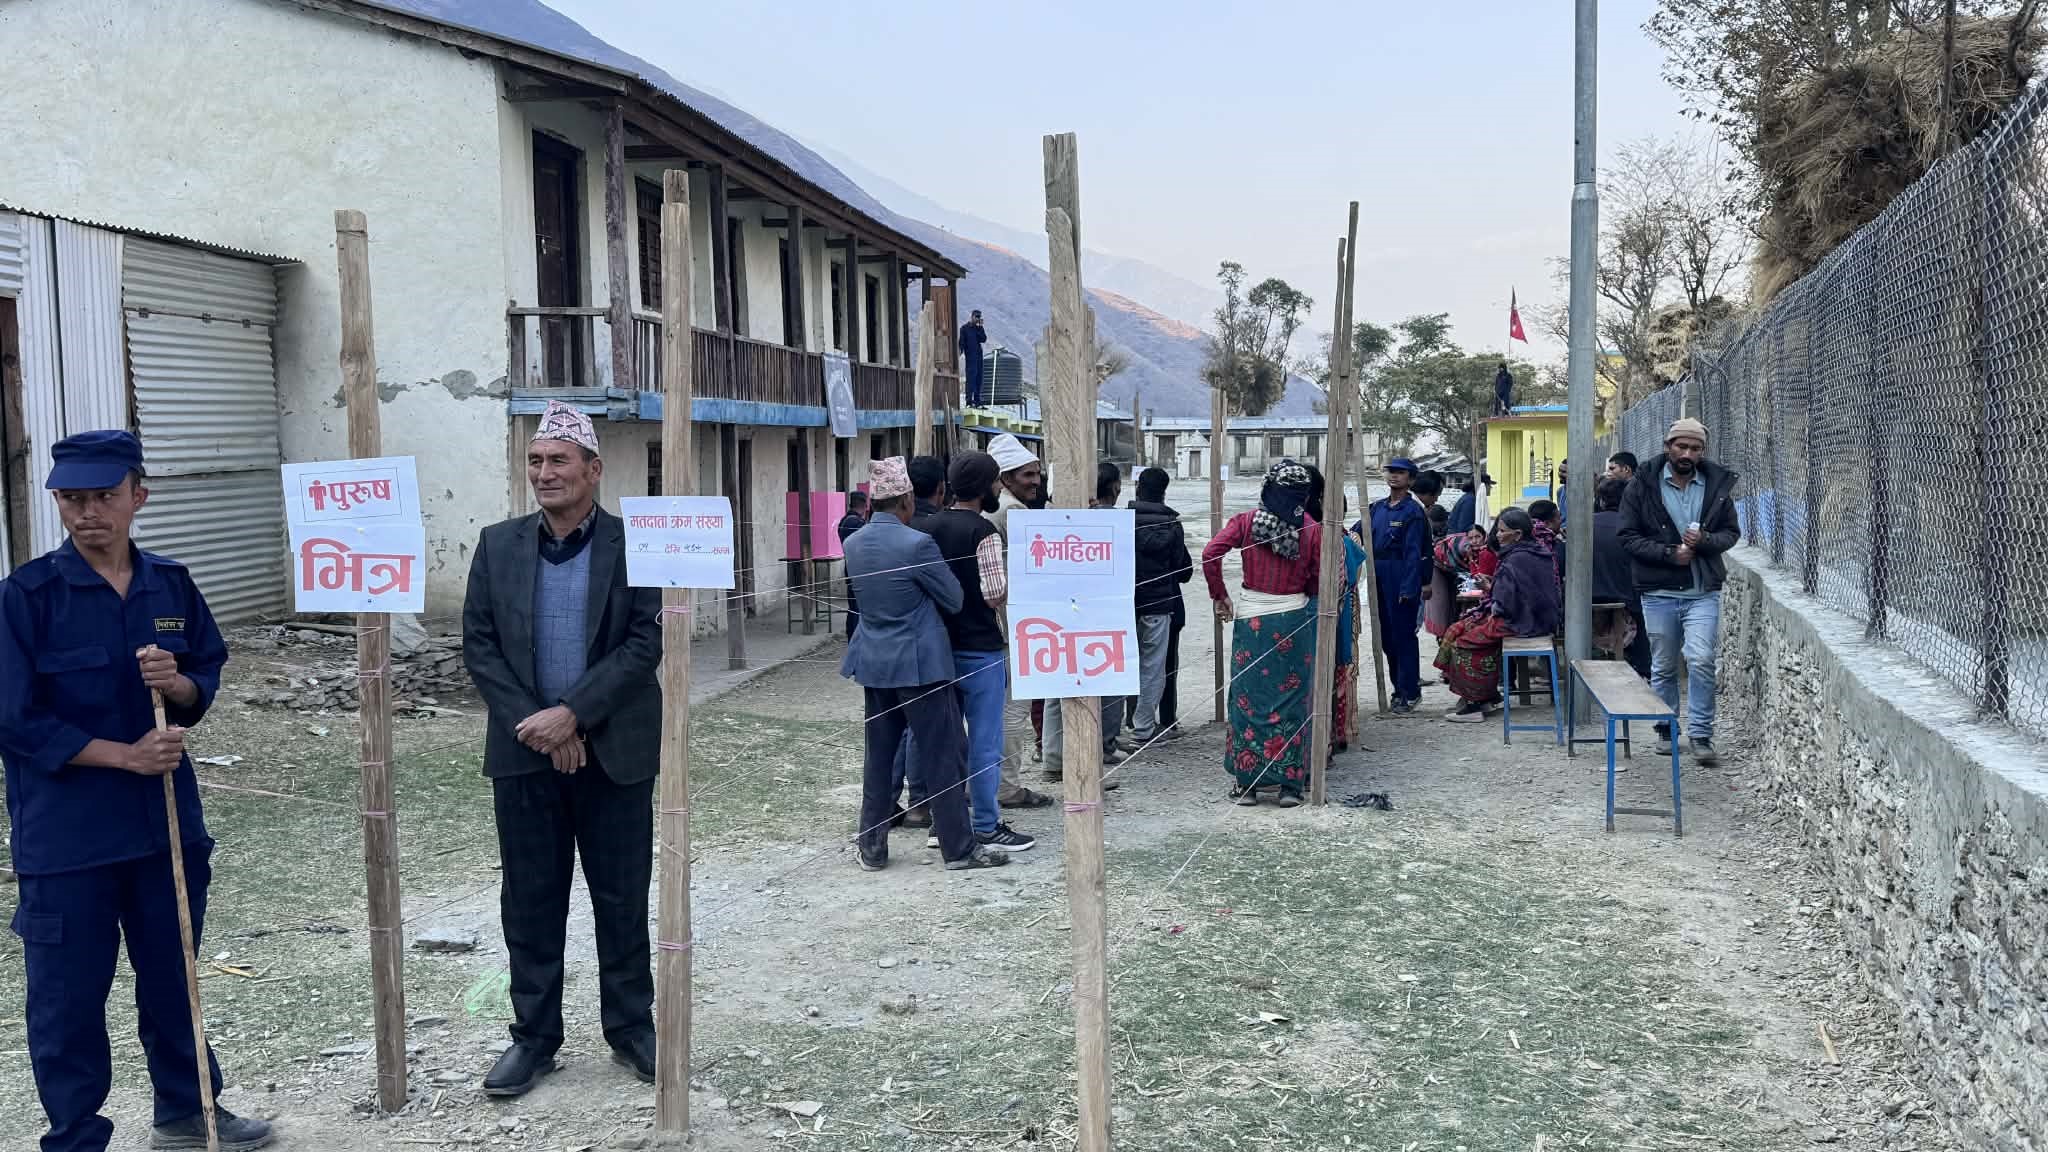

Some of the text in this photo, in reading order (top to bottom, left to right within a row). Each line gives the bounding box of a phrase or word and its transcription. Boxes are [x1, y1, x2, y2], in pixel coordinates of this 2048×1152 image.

[630, 513, 724, 530] मतदाता क्रम संख्या
[300, 538, 416, 595] भित्र
[1047, 534, 1113, 562] महिला
[1015, 617, 1127, 677] भित्र
